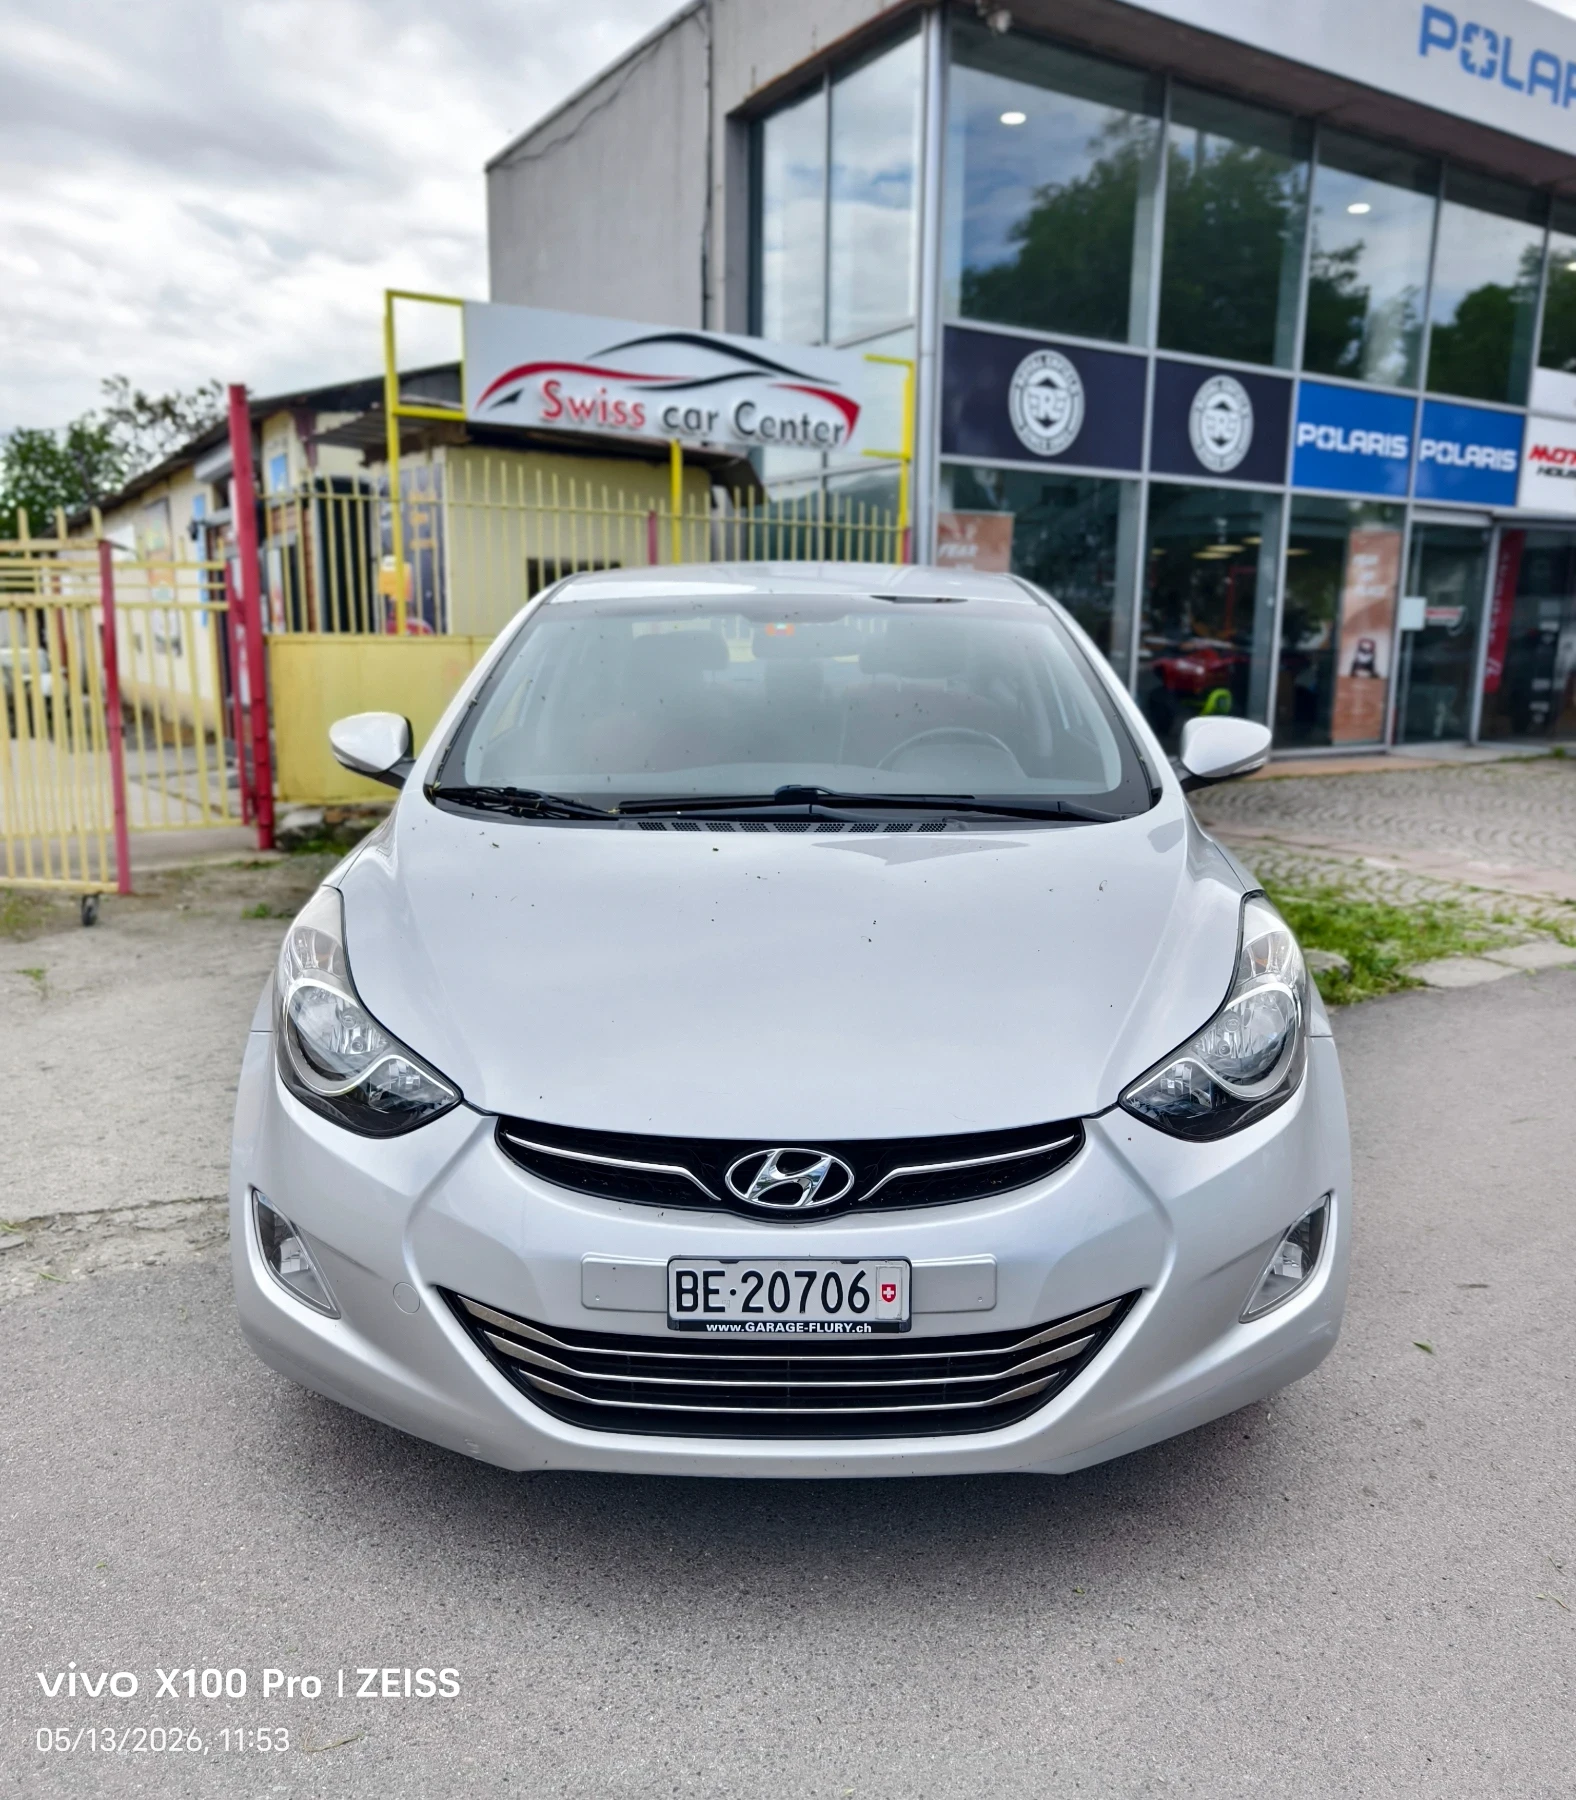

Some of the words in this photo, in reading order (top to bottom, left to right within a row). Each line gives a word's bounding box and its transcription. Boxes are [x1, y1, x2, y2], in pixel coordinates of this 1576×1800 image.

[541, 380, 646, 428] Swiss
[662, 405, 719, 431] car
[734, 400, 845, 445] Center
[1297, 422, 1409, 459] POLARIS
[1419, 438, 1518, 472] POLARIS
[706, 1322, 872, 1334] www.GARAGE-FLURY.ch
